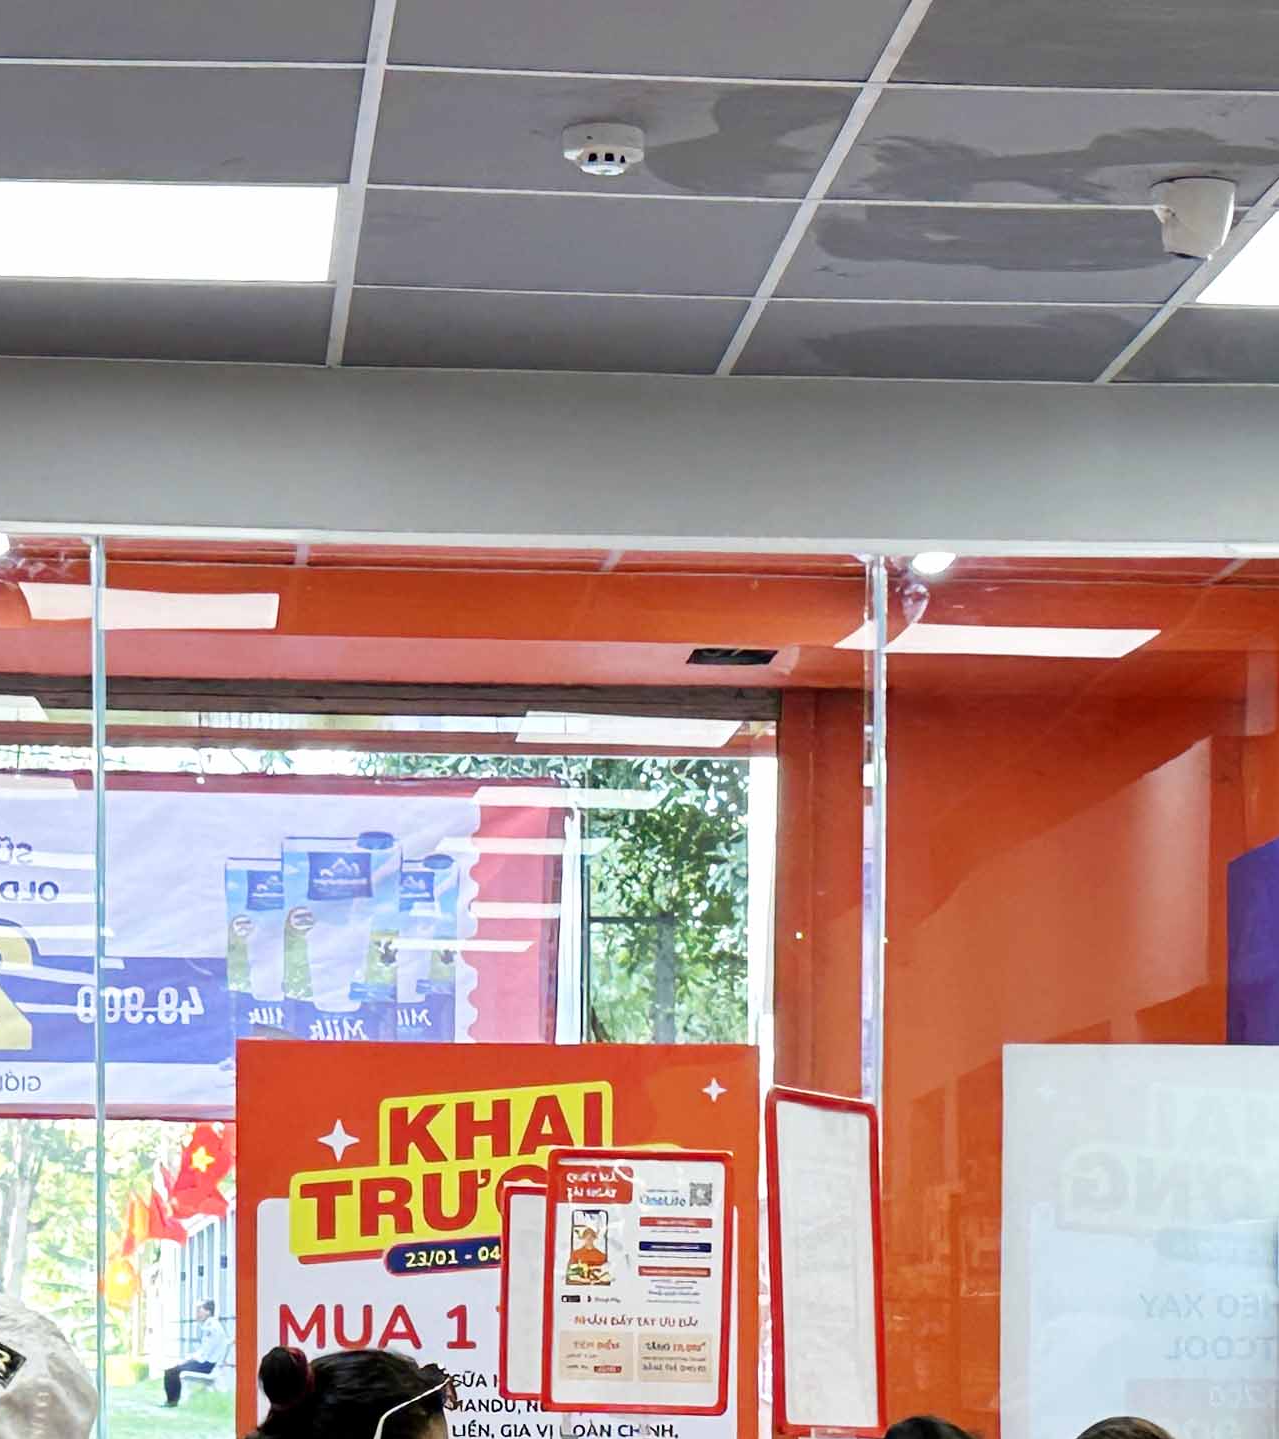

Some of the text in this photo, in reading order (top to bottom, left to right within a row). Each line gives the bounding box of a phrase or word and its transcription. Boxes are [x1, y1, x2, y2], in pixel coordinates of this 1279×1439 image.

[389, 1091, 604, 1165] KHAI
[404, 1249, 459, 1268] 23/01
[278, 1303, 477, 1350] MUA 1
[500, 1423, 531, 1438] GIA
[559, 1419, 612, 1438] OÀN
